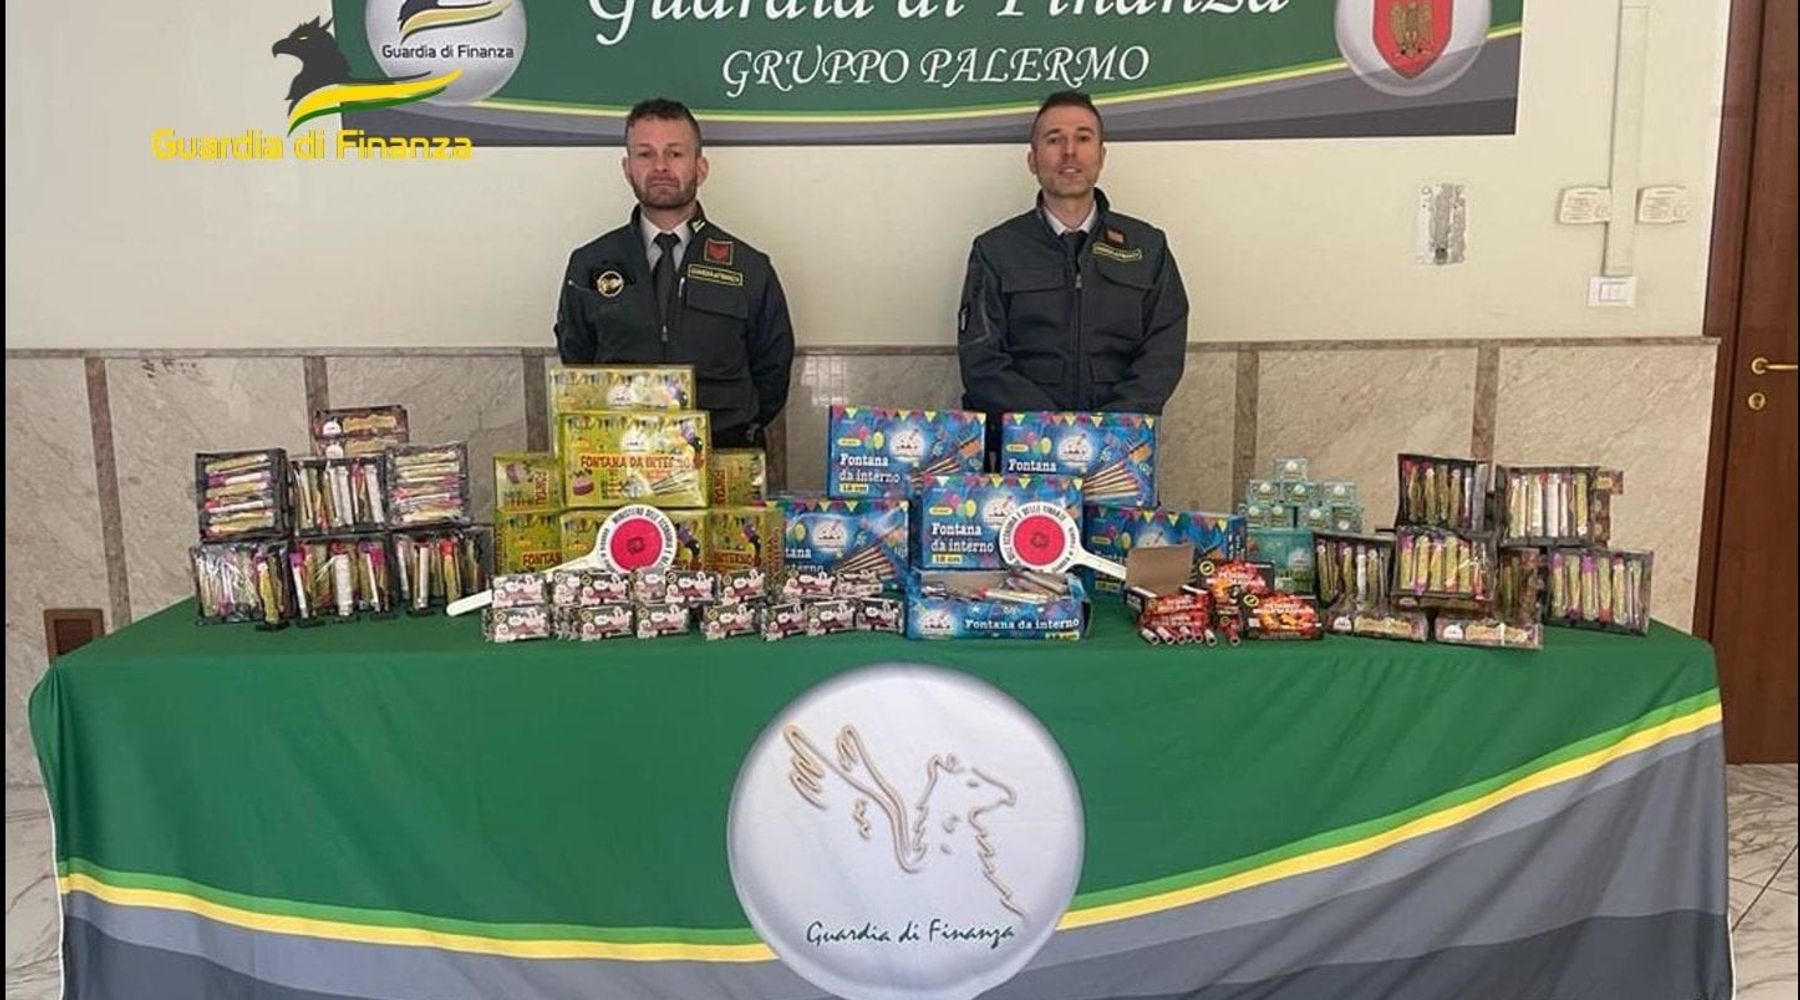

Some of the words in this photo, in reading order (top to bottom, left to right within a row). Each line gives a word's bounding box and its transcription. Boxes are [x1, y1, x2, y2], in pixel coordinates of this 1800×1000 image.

[996, 0, 1290, 19] inanza
[382, 45, 437, 58] Guardia
[440, 45, 454, 58] di
[457, 45, 514, 58] Finanza
[722, 45, 910, 98] GRUPPO
[919, 45, 1150, 89] PALERMO
[580, 455, 627, 468] FONTANA
[630, 455, 644, 468] DA
[839, 453, 889, 467] Fontana
[1008, 458, 1057, 472] Fontana
[839, 469, 854, 482] da
[857, 469, 900, 483] interno
[931, 522, 982, 536] Fontana
[931, 538, 946, 552] da
[948, 538, 995, 552] interno
[522, 552, 562, 566] FONTAN
[785, 547, 812, 559] tana
[964, 618, 1015, 630] Fontana
[1017, 618, 1033, 630] da
[1035, 617, 1080, 630] interno
[806, 920, 891, 947] Guardia
[899, 921, 919, 943] di
[928, 918, 1015, 949] Finanza
